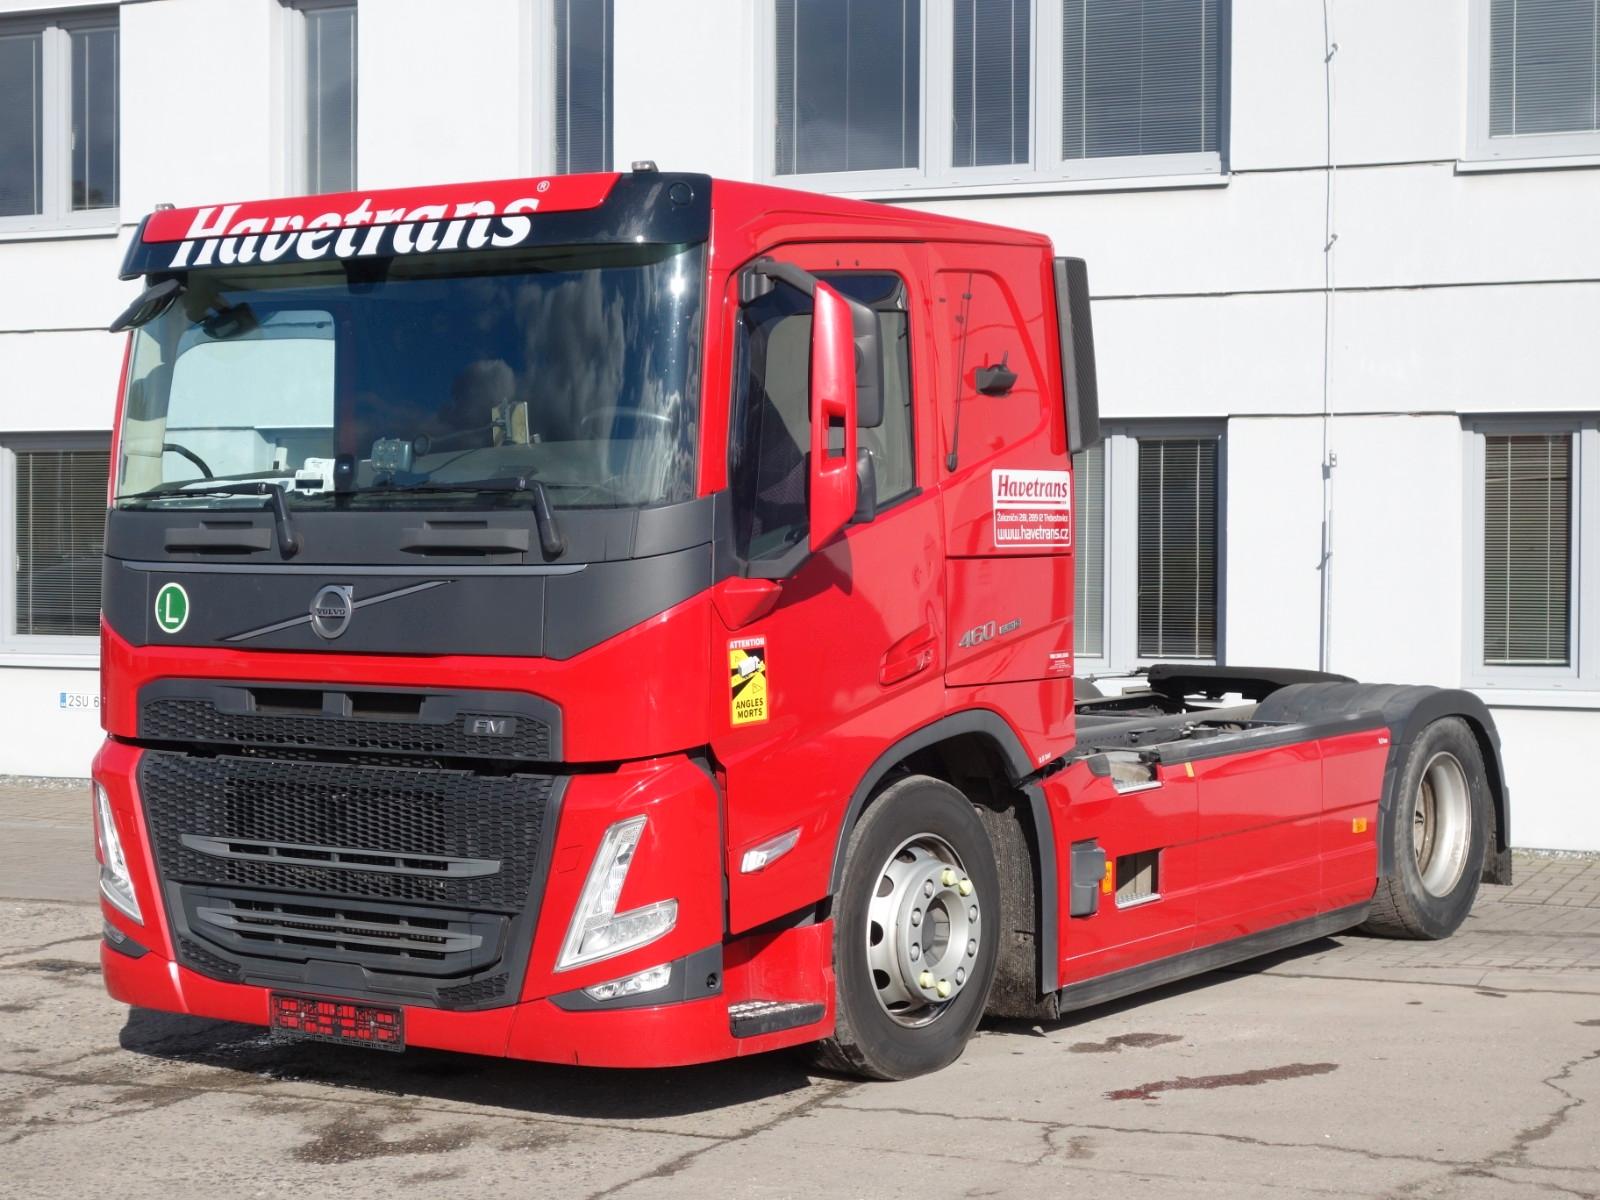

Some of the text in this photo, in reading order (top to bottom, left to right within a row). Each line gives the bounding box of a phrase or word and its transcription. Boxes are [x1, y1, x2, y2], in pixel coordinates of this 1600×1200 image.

[168, 198, 541, 268] Havetrans
[998, 475, 1067, 497] Havetrans
[997, 525, 1069, 540] www.havetrans.cz
[165, 592, 180, 624] L
[317, 608, 346, 616] VOLVO
[958, 620, 996, 648] 460
[730, 638, 764, 648] ATTENTION
[68, 695, 89, 707] 2SU
[736, 698, 763, 709] ANGLES
[738, 708, 762, 719] MORTS
[472, 719, 505, 735] FM
